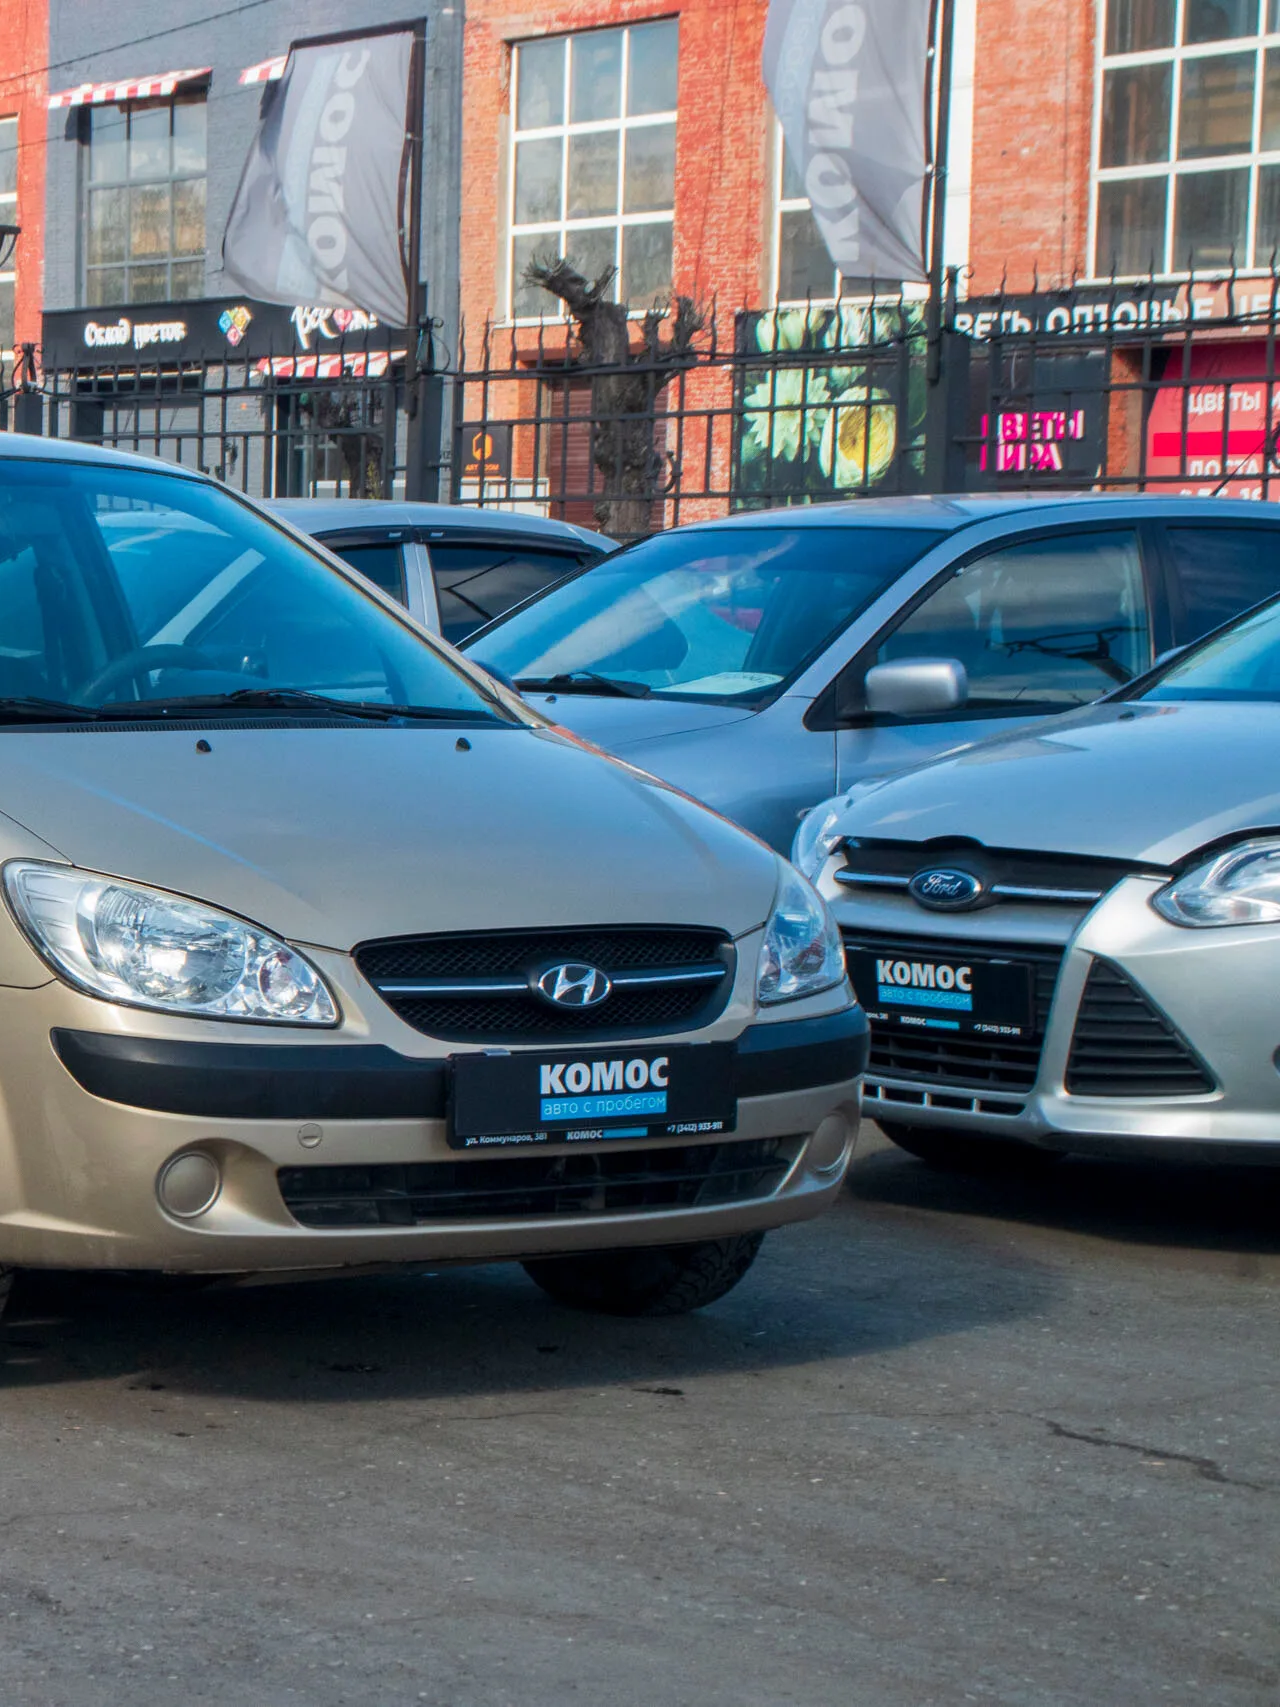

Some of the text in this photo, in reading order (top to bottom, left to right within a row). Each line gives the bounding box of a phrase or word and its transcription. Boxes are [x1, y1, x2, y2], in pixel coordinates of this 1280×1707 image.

[805, 0, 868, 262] КОМО
[922, 873, 962, 896] Ford
[876, 959, 973, 992] КОМОС
[540, 1056, 669, 1095] КОМОС
[544, 1095, 666, 1116] авто с пробегом
[566, 1130, 602, 1140] КОМОС
